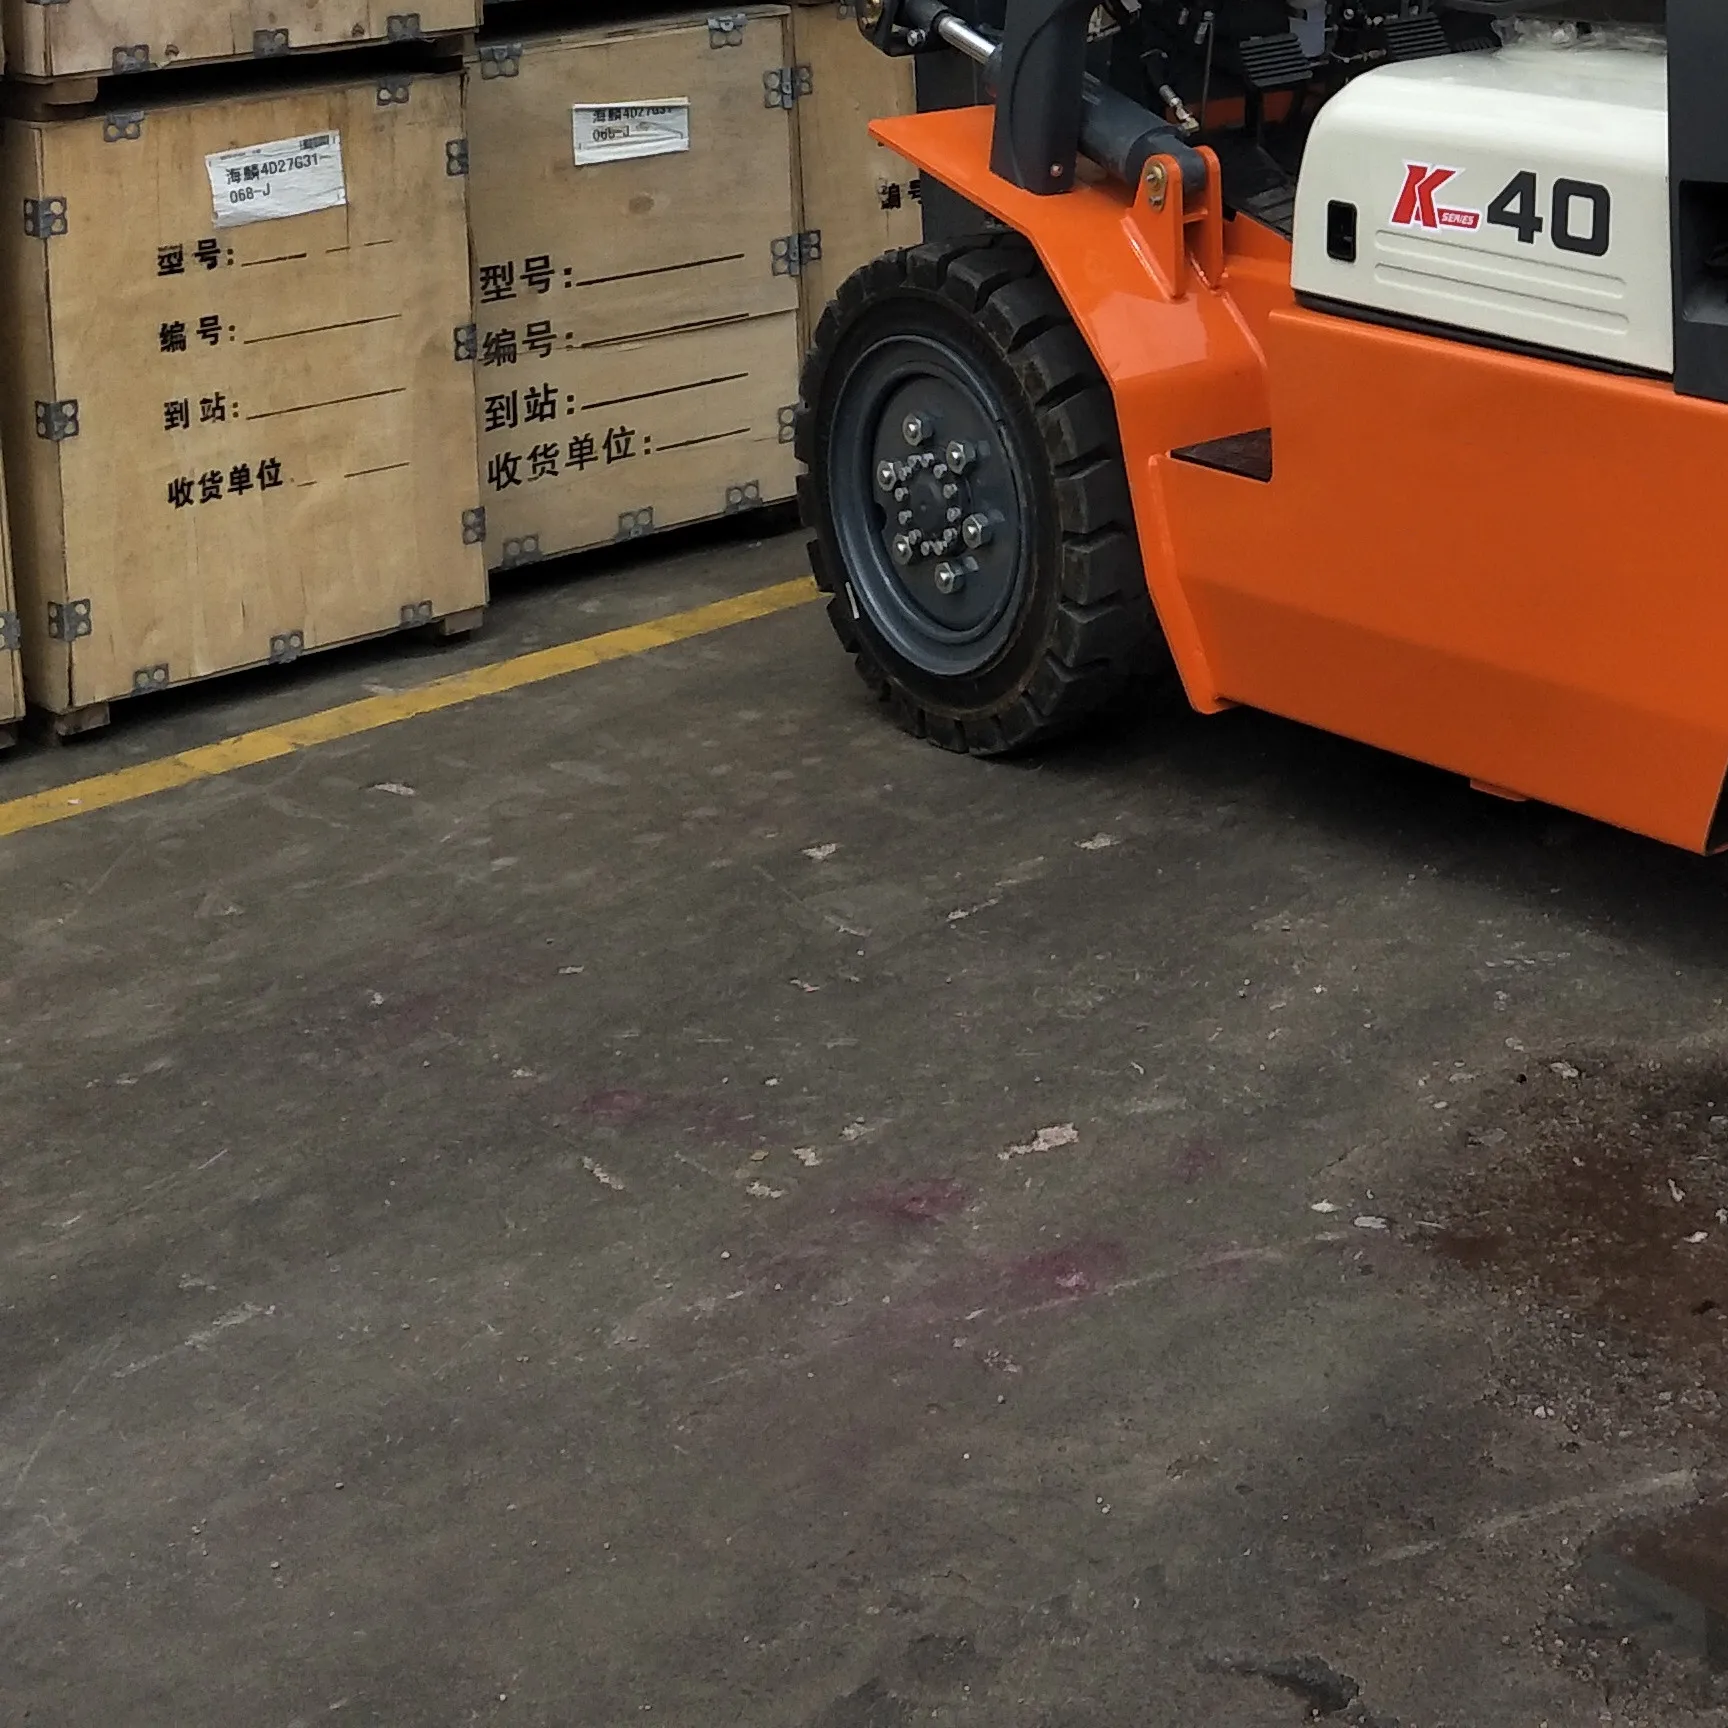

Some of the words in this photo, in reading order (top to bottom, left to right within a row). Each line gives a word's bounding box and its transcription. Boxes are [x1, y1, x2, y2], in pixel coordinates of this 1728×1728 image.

[229, 182, 271, 204] 068-J
[1391, 164, 1457, 229] K
[1486, 170, 1611, 257] 40
[479, 254, 573, 303] 型号：
[159, 314, 236, 353] 编号：
[481, 320, 574, 367] 编号：
[164, 391, 239, 431] 到站：
[484, 382, 575, 432] 到站：
[487, 425, 652, 492] 收货单位：
